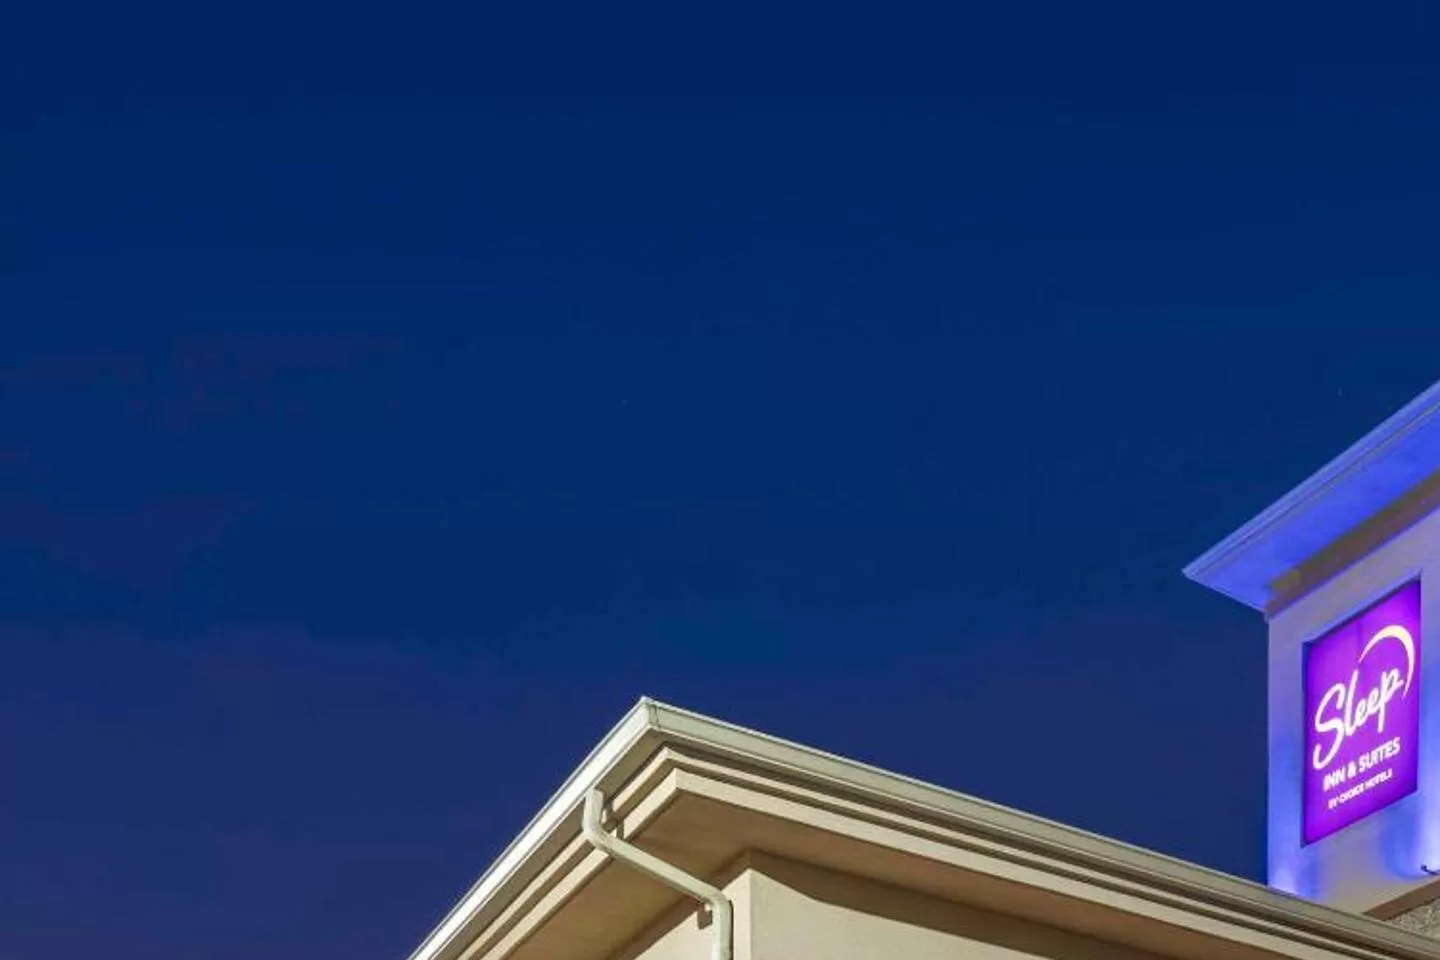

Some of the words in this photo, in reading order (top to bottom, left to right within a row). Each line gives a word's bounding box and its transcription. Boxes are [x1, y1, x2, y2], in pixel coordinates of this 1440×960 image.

[1313, 668, 1404, 770] Sleep
[1323, 764, 1346, 792] INN
[1347, 760, 1357, 780] &
[1358, 736, 1401, 773] SUITES
